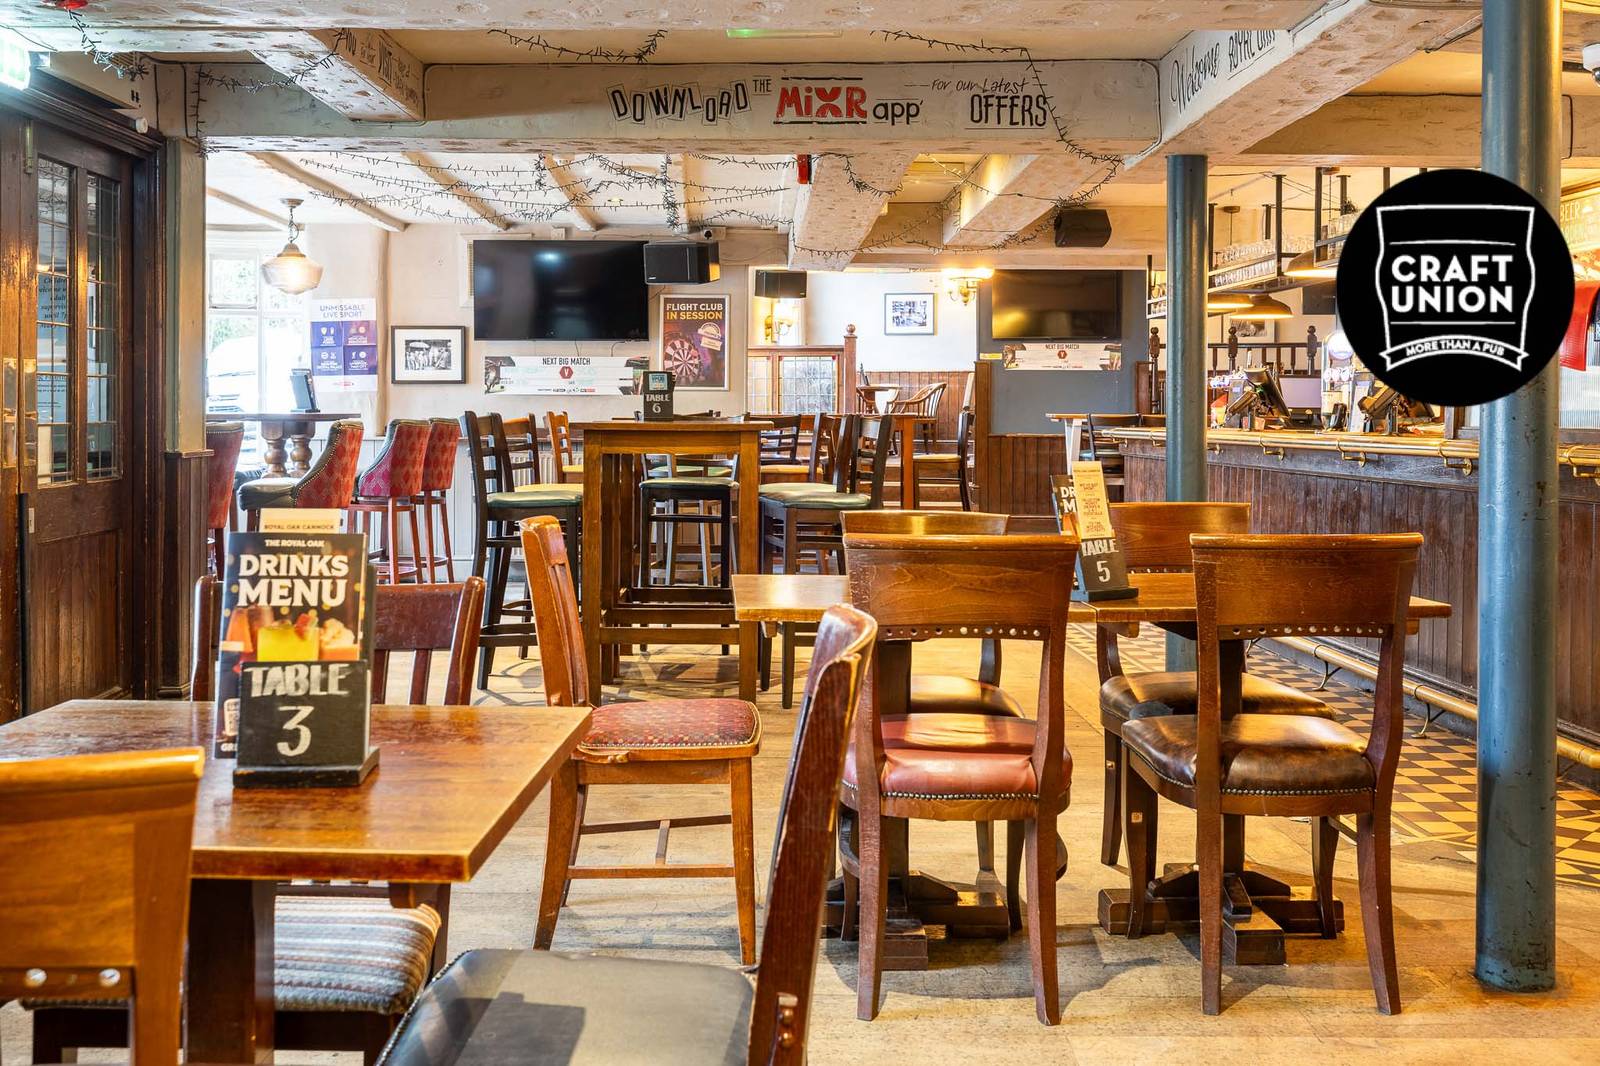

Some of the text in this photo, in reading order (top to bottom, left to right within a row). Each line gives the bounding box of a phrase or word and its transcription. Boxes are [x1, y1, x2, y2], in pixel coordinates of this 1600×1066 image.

[1170, 43, 1220, 114] Welcome
[611, 83, 748, 122] DOWNLOAD
[753, 79, 772, 93] THE
[970, 94, 1047, 126] OFFERS
[666, 303, 723, 311] FLIGHT CLUB
[666, 311, 723, 320] IN SESSION
[542, 357, 591, 366] NEXT BIG MATCH
[645, 394, 670, 402] TABLE
[652, 402, 662, 413] 6
[264, 539, 325, 547] THE ROYAL OAK
[1081, 539, 1119, 556] TABLE
[238, 554, 349, 577] DRINKS
[1096, 560, 1111, 582] 5
[237, 579, 347, 607] MENU
[243, 663, 352, 697] TABLE
[276, 705, 315, 757] 3
